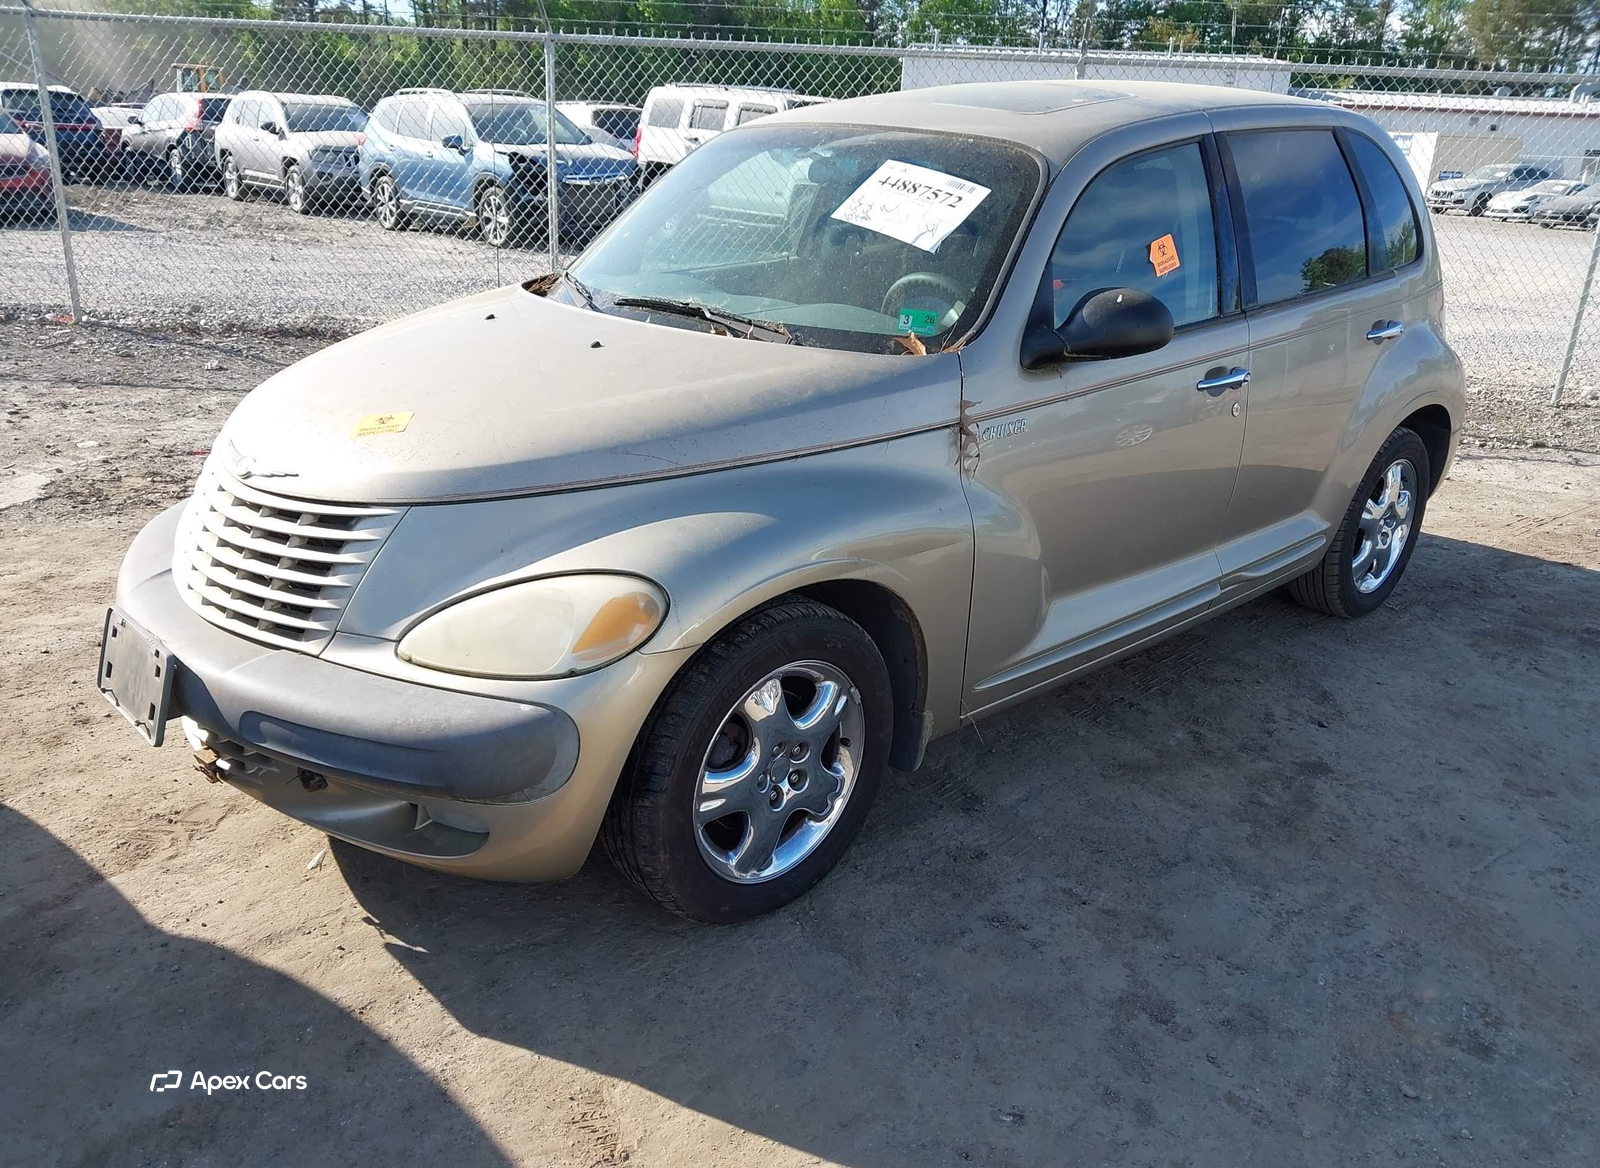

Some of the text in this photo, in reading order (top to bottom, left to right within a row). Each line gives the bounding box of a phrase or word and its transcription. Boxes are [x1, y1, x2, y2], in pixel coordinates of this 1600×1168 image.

[878, 175, 964, 209] 44887572
[903, 314, 935, 325] 3 26
[981, 418, 1027, 442] CRUISER
